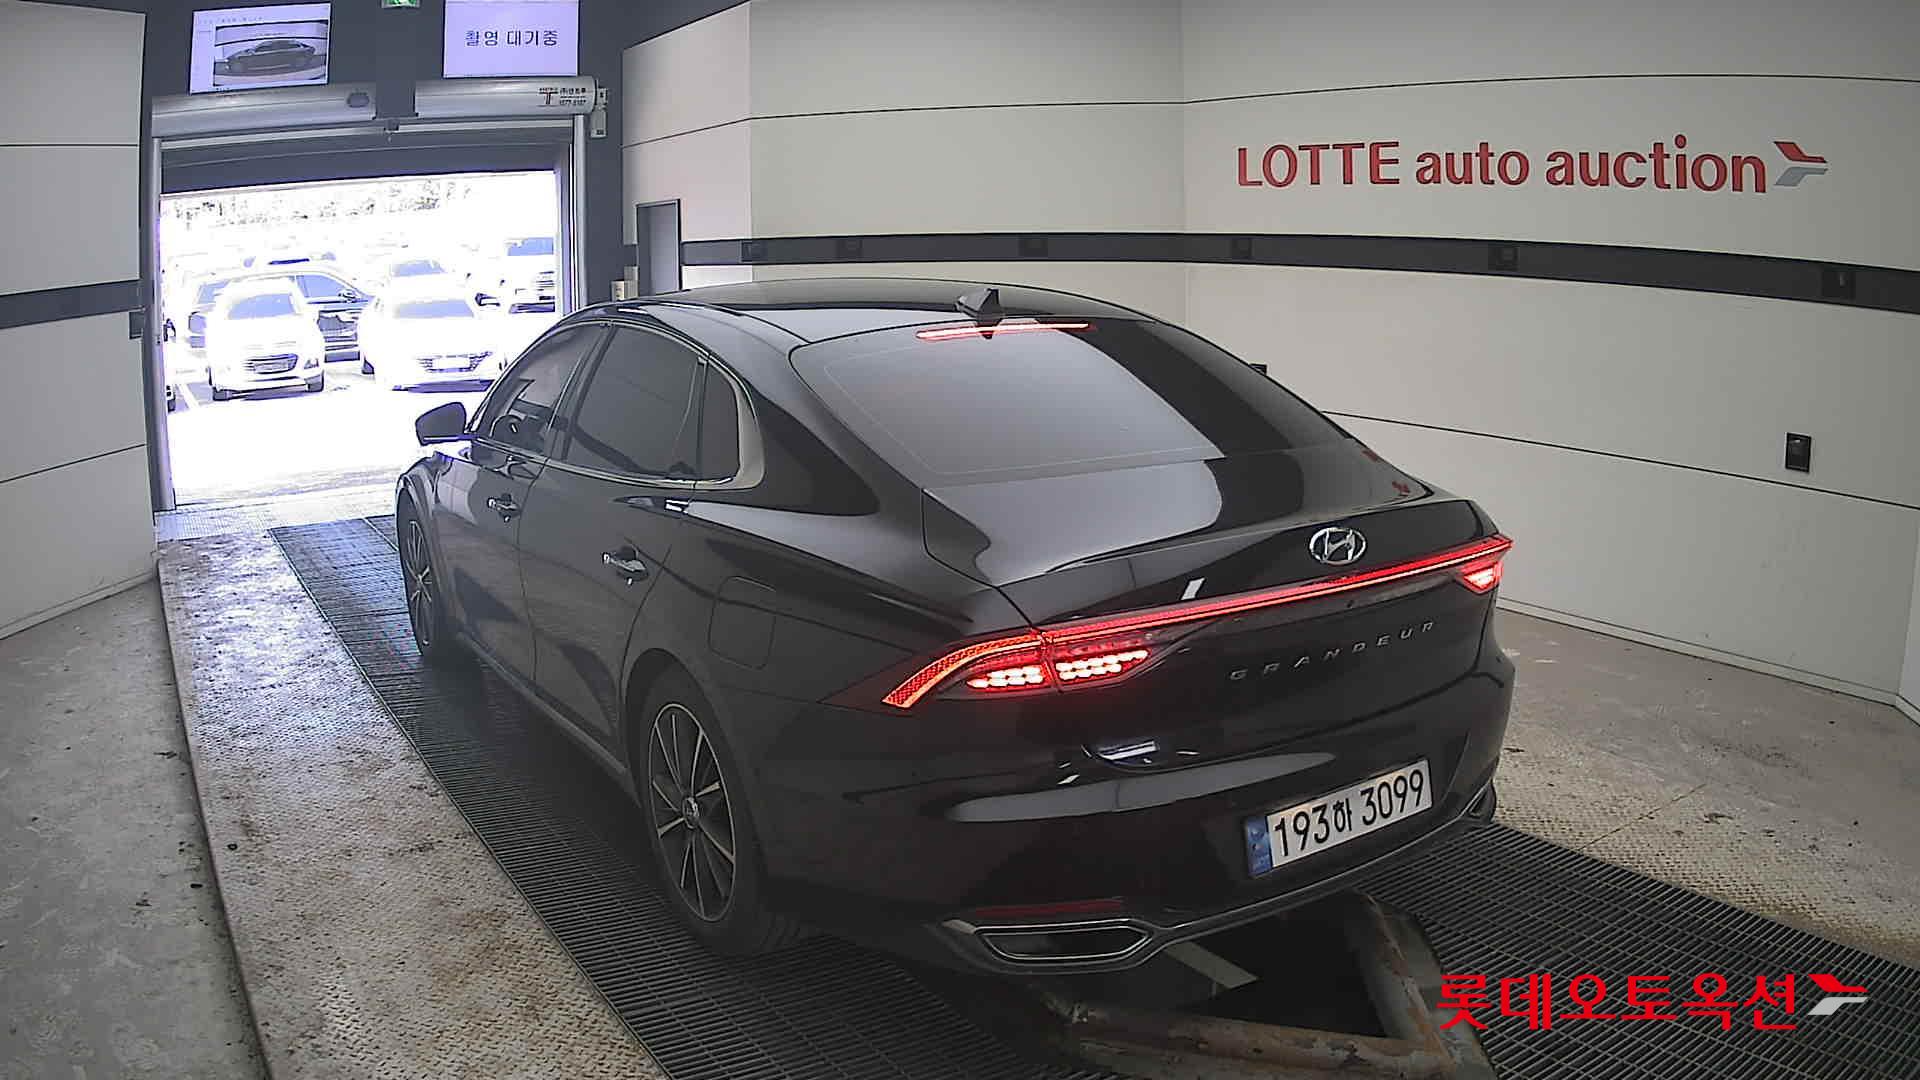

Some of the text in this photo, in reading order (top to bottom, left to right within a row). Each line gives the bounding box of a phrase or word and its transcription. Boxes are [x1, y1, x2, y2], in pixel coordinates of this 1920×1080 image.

[506, 30, 558, 47] 대기중
[1236, 134, 1767, 195] LOTTE auto auction
[1230, 621, 1434, 680] GRANDEUR
[1273, 767, 1425, 858] 193하 3099
